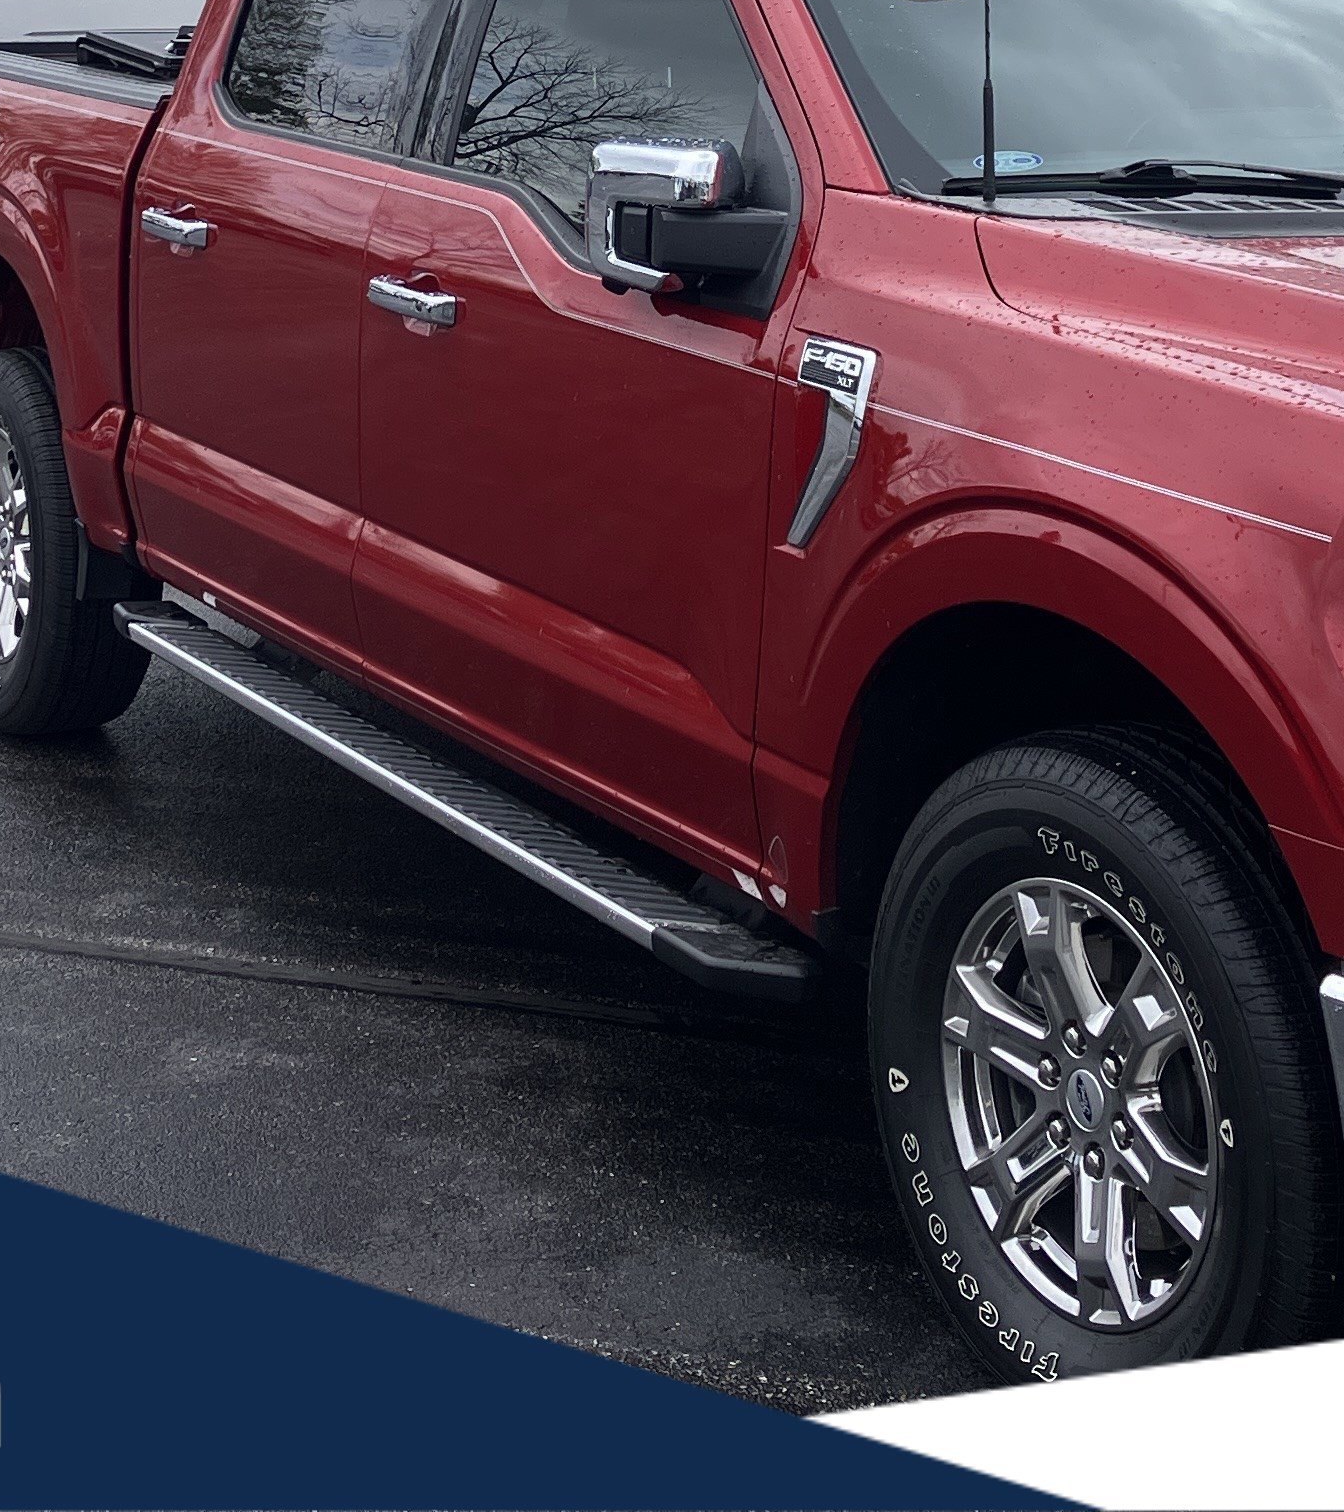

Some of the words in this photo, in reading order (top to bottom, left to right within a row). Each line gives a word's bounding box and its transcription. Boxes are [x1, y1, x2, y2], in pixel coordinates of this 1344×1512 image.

[803, 348, 862, 377] F-150
[836, 375, 854, 388] XLT
[1037, 826, 1218, 1074] Firestone
[901, 1132, 1060, 1383] Firestone
